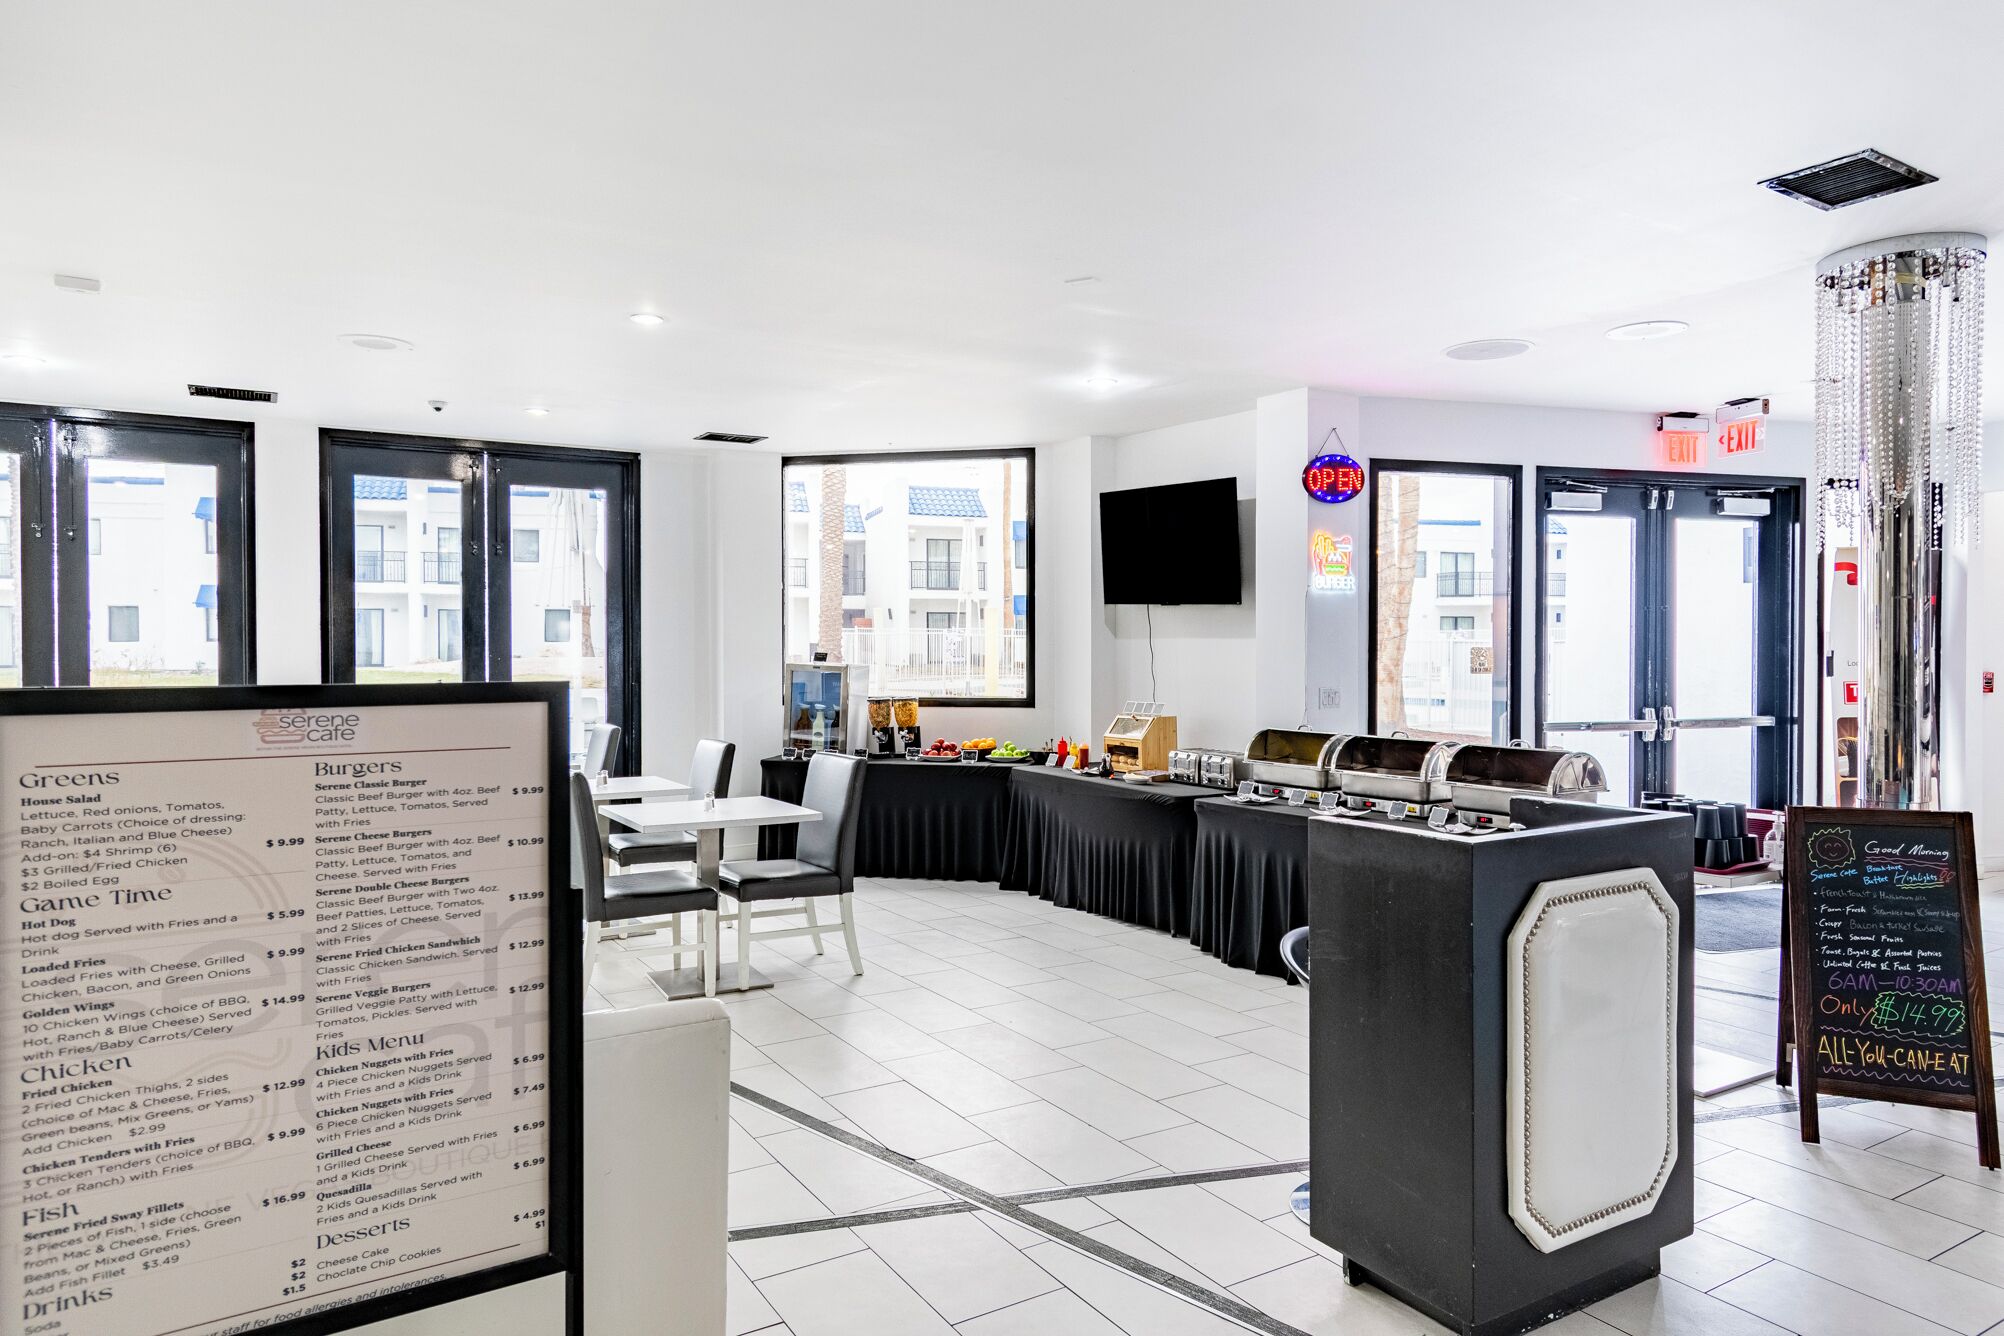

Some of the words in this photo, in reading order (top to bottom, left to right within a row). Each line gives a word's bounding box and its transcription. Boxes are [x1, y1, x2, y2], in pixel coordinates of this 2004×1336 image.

[1727, 420, 1758, 453] EXIT
[1668, 435, 1698, 463] EXIT
[1308, 468, 1361, 490] OPEN
[1314, 574, 1355, 590] BURGER
[280, 714, 359, 729] serene
[315, 761, 401, 778] Burgers
[19, 772, 119, 788] Greens
[314, 783, 351, 791] Serene
[353, 779, 389, 789] Classic
[392, 779, 427, 788] Burger
[20, 797, 62, 806] House
[65, 793, 100, 804] Salad
[314, 794, 354, 804] Classic
[357, 792, 384, 801] Beef
[386, 791, 424, 800] Burger
[426, 788, 449, 797] with
[477, 785, 500, 794] Beef
[452, 798, 488, 807] Served
[82, 806, 110, 816] Red
[20, 825, 57, 835] Baby
[62, 820, 112, 832] Carrots
[117, 818, 168, 832] (Choice
[172, 815, 186, 827] of
[315, 819, 340, 829] with
[343, 818, 371, 827] Fries
[73, 835, 115, 845] Italian
[118, 831, 143, 842] and
[147, 830, 176, 841] Blue
[180, 826, 232, 837] Cheese)
[314, 835, 351, 843] Serene
[354, 832, 390, 840] Cheese
[392, 830, 432, 838] Burgers
[82, 849, 100, 859] $4
[105, 844, 153, 856] Shrimp
[156, 843, 177, 853] (6)
[1864, 840, 1904, 856] Good
[1908, 844, 1949, 860] Morning
[20, 867, 38, 878] $3
[43, 859, 131, 875] Grilled/Fried
[135, 857, 187, 868] Chicken
[20, 881, 38, 892] $2
[43, 877, 87, 889] Boiled
[92, 876, 119, 886] Egg
[315, 888, 352, 896] Serene
[354, 882, 391, 893] Double
[393, 880, 428, 889] Cheese
[431, 877, 469, 886] Burgers
[20, 895, 99, 913] Game
[109, 888, 171, 904] Time
[21, 920, 46, 930] Hot
[50, 918, 76, 927] Dog
[21, 934, 47, 944] Hot
[51, 931, 80, 941] dog
[84, 924, 132, 937] Served
[135, 921, 164, 933] with
[168, 919, 199, 928] Fries
[202, 914, 226, 925] and
[1820, 931, 1843, 940] Fresh
[1881, 934, 1904, 943] Fruits
[20, 945, 61, 958] Drink
[315, 953, 352, 962] Serene
[355, 947, 382, 958] Fried
[384, 943, 425, 954] Chicken
[22, 960, 69, 974] Loaded
[73, 957, 106, 968] Fries
[315, 993, 352, 1003] Serene
[354, 986, 388, 998] Veggie
[391, 982, 430, 993] Burgers
[22, 1007, 70, 1019] Golden
[73, 1001, 115, 1012] Wings
[1820, 994, 1874, 1027] Only
[1876, 996, 1961, 1031] $14.99
[316, 1041, 360, 1060] Kids
[368, 1033, 424, 1052] Menu
[20, 1056, 132, 1083] Chicken
[315, 1064, 358, 1076] Chicken
[361, 1057, 401, 1069] Nuggets
[404, 1052, 426, 1062] with
[429, 1048, 453, 1058] Fries
[22, 1086, 57, 1100] Fried
[60, 1080, 112, 1093] Chicken
[316, 1106, 358, 1118] Chicken
[361, 1097, 402, 1110] Nuggets
[404, 1092, 426, 1102] with
[429, 1088, 453, 1098] Fries
[128, 1123, 166, 1138] $2.99
[22, 1159, 76, 1174] Chicken
[79, 1149, 130, 1163] Tenders
[134, 1141, 161, 1153] with
[164, 1137, 194, 1148] Fries
[316, 1145, 353, 1160] Grilled
[355, 1140, 391, 1152] Cheese
[316, 1182, 372, 1201] Quesadilla
[22, 1202, 79, 1226] Fish
[24, 1226, 69, 1241] Serene
[73, 1215, 107, 1231] Fried
[110, 1210, 143, 1223] Sway
[146, 1202, 184, 1215] Fillets
[316, 1218, 410, 1249] Desserts
[142, 1255, 180, 1271] $3.49
[291, 1258, 306, 1268] $2
[316, 1254, 358, 1269] Cheese
[361, 1247, 389, 1259] Cake
[370, 1257, 395, 1269] Chip
[398, 1247, 441, 1264] Cookies
[291, 1271, 306, 1281] $2
[282, 1283, 306, 1296] $1.5
[23, 1287, 112, 1320] Drinks
